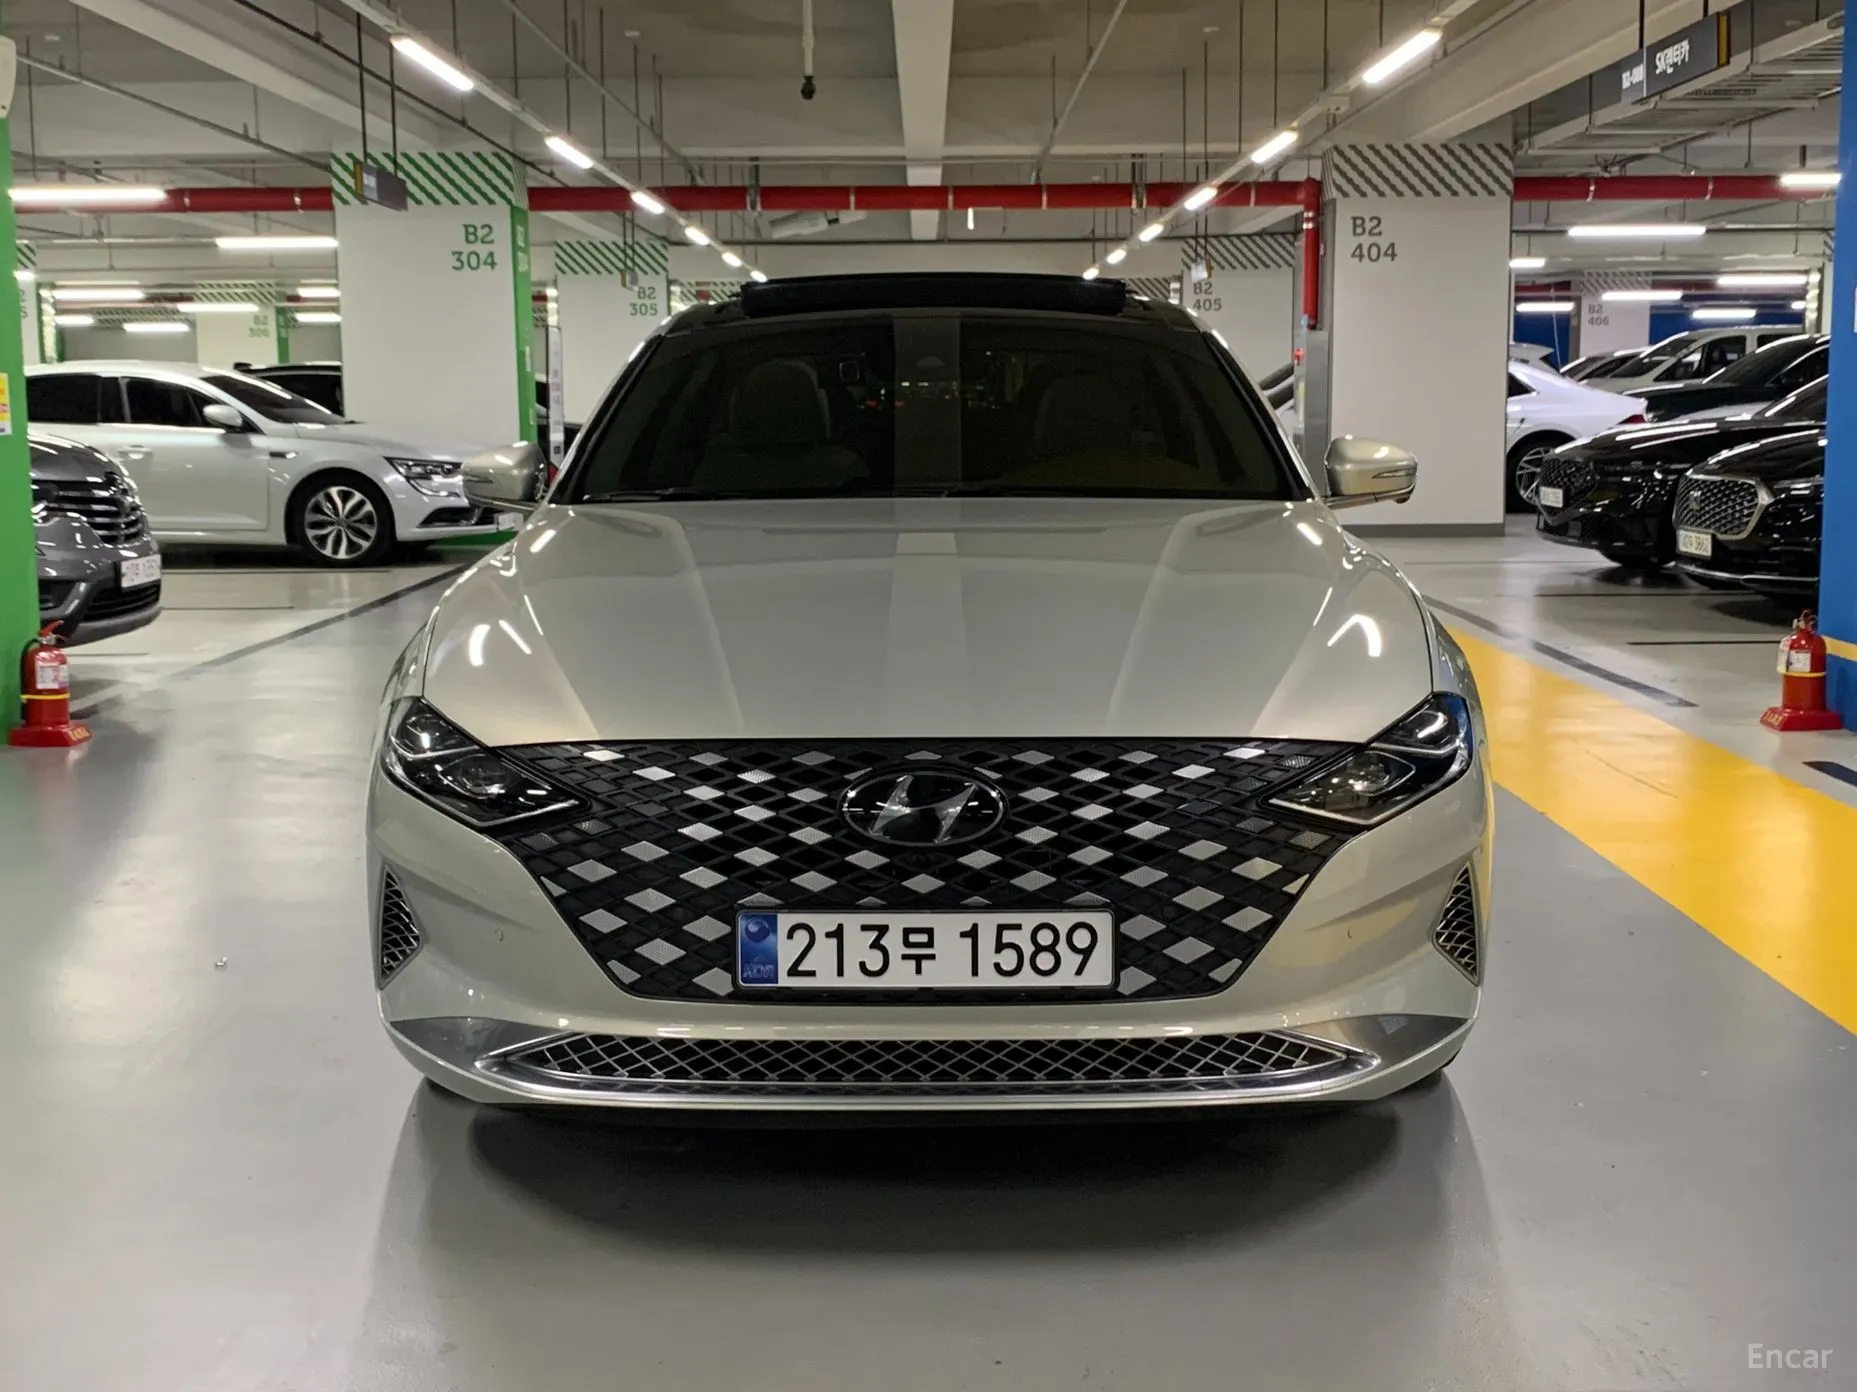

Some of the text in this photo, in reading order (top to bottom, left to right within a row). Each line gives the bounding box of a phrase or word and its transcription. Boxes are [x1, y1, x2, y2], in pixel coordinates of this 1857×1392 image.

[1655, 39, 1690, 75] SK렌터카
[463, 223, 495, 245] B2
[1350, 215, 1383, 237] B2
[451, 250, 498, 271] 304
[1350, 242, 1398, 263] 404
[637, 286, 657, 300] B2
[1193, 281, 1213, 296] B2
[629, 303, 658, 316] 305
[1193, 298, 1222, 311] 405
[1588, 303, 1603, 315] B2
[1588, 316, 1610, 326] 406
[786, 922, 1098, 977] 213무 1589
